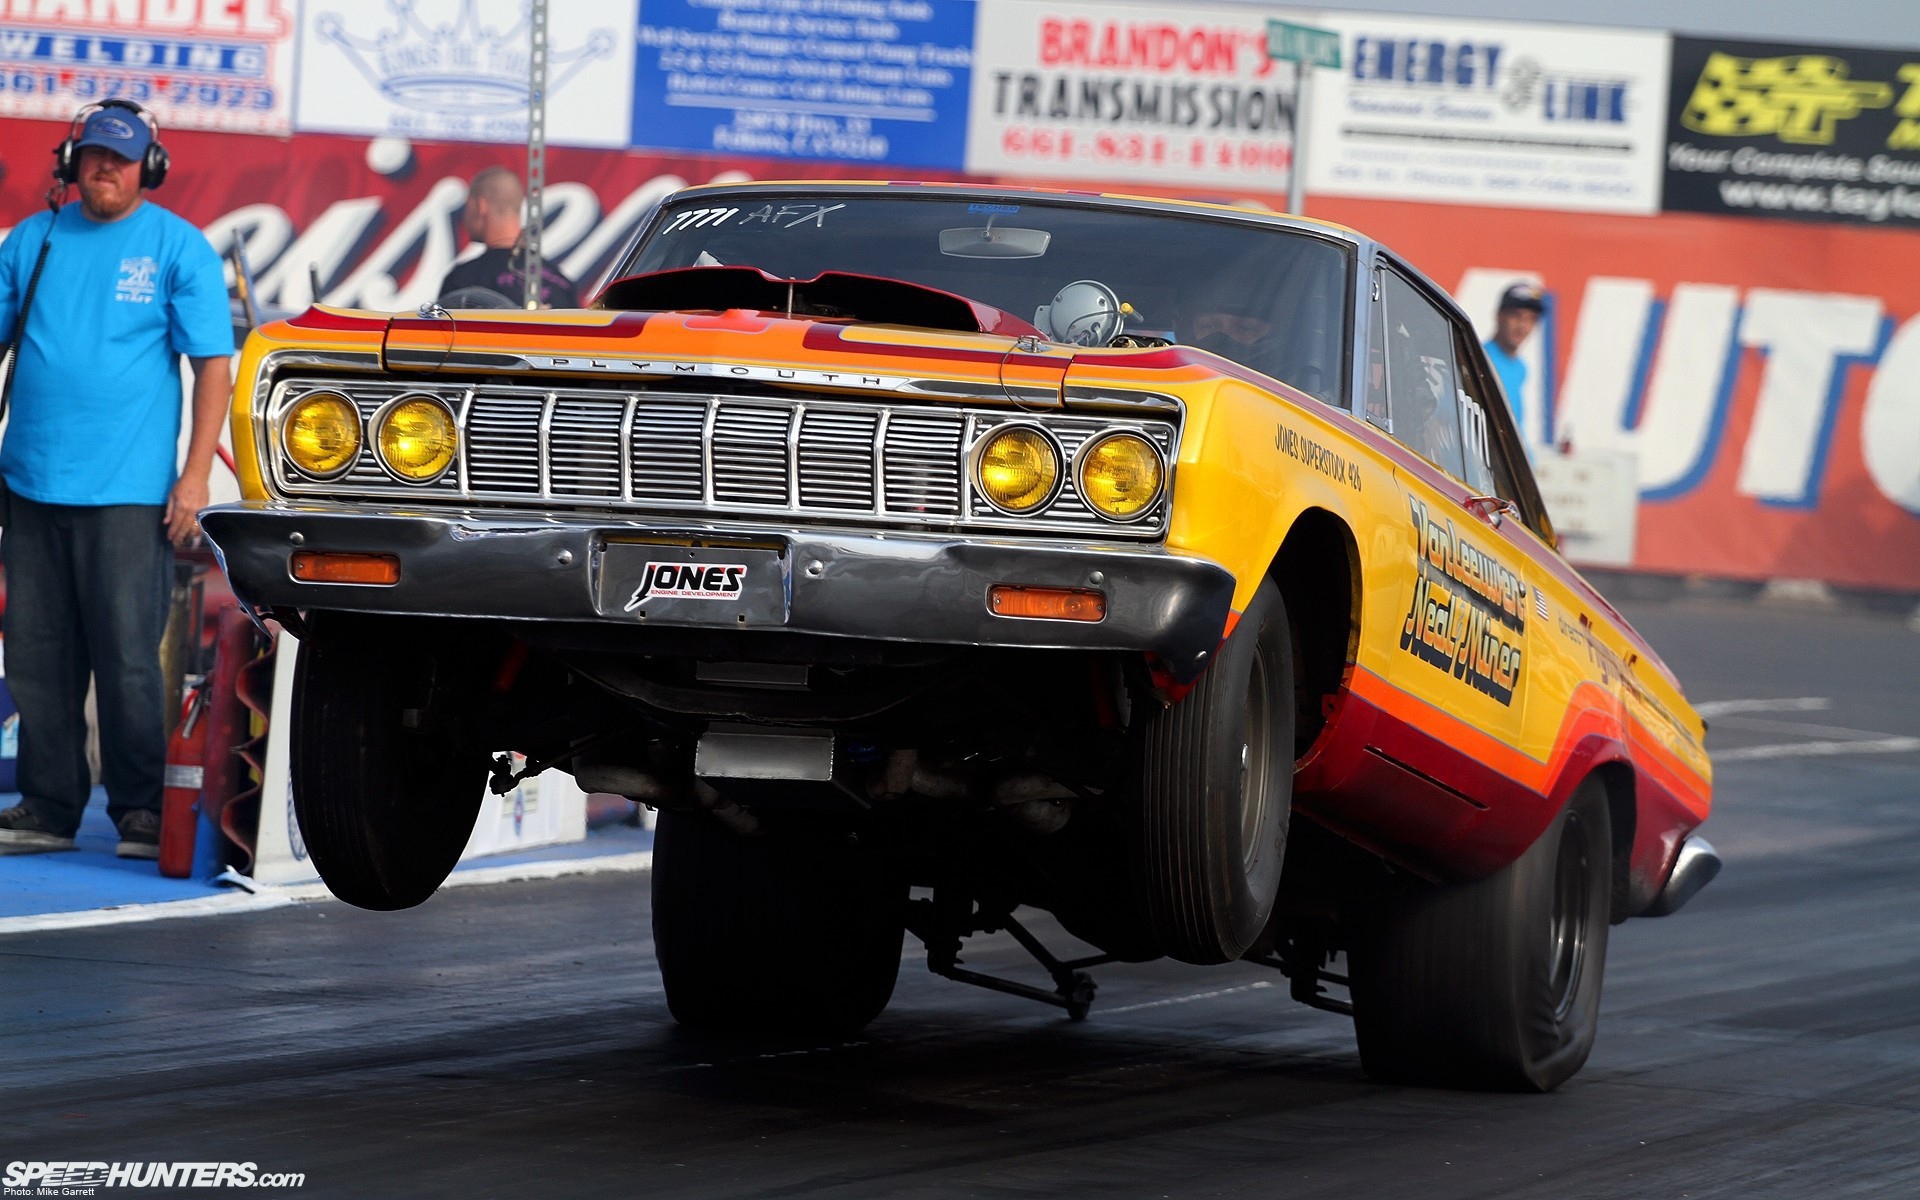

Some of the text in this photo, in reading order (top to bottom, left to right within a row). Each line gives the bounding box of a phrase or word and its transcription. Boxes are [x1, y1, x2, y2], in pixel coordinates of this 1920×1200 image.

[0, 31, 261, 71] WELDING
[1040, 17, 1277, 77] BRANDON'S
[1353, 37, 1503, 88] ENERGY
[994, 71, 1294, 133] TRANSMISSION
[1667, 142, 1731, 174] Your
[1732, 146, 1865, 183] Complete
[738, 202, 847, 229] AFX
[550, 358, 881, 386] PLYMOUTH
[1274, 422, 1362, 493] JONES SUPERSTOCK 426
[630, 564, 744, 605] JONES
[681, 590, 737, 598] DEVELOPMENT
[1400, 574, 1456, 672] Neal
[1457, 605, 1522, 706] Miner
